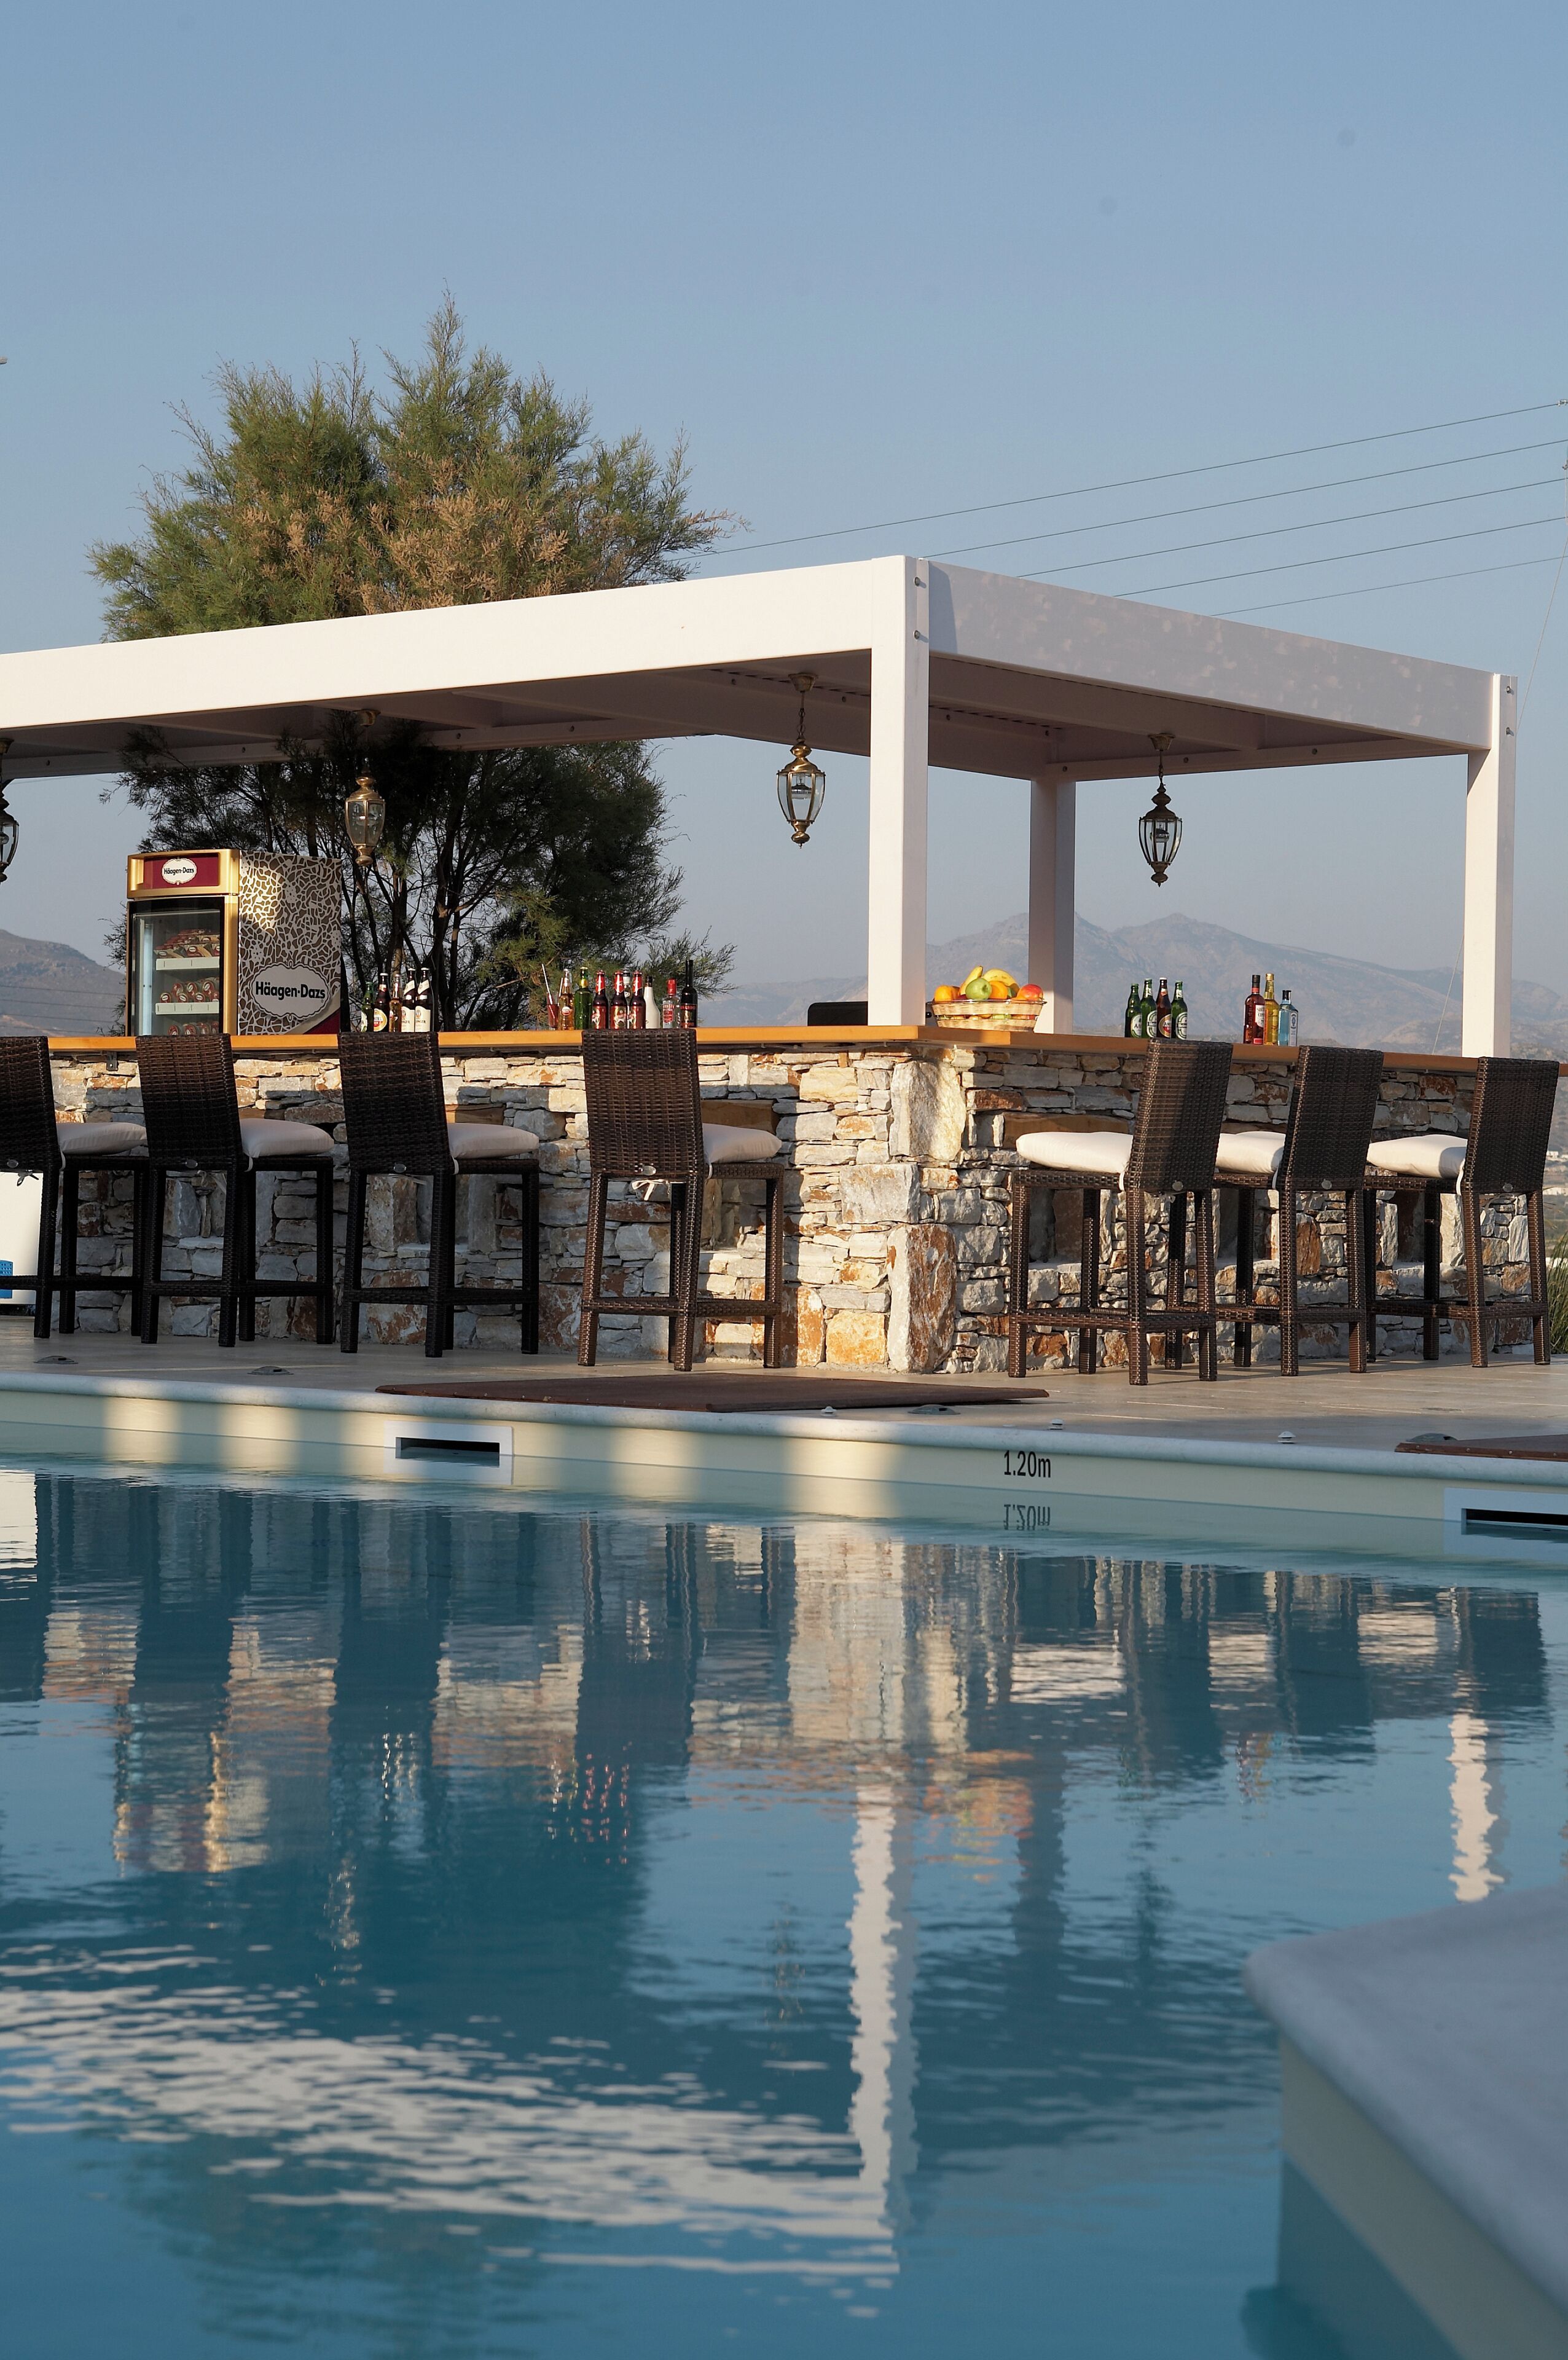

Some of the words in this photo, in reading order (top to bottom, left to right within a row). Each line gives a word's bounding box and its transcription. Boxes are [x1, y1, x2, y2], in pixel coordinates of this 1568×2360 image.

[163, 867, 195, 876] Häagen-Dazs
[255, 981, 326, 1001] Häagen-Dazs
[1004, 1450, 1051, 1478] 1.20m
